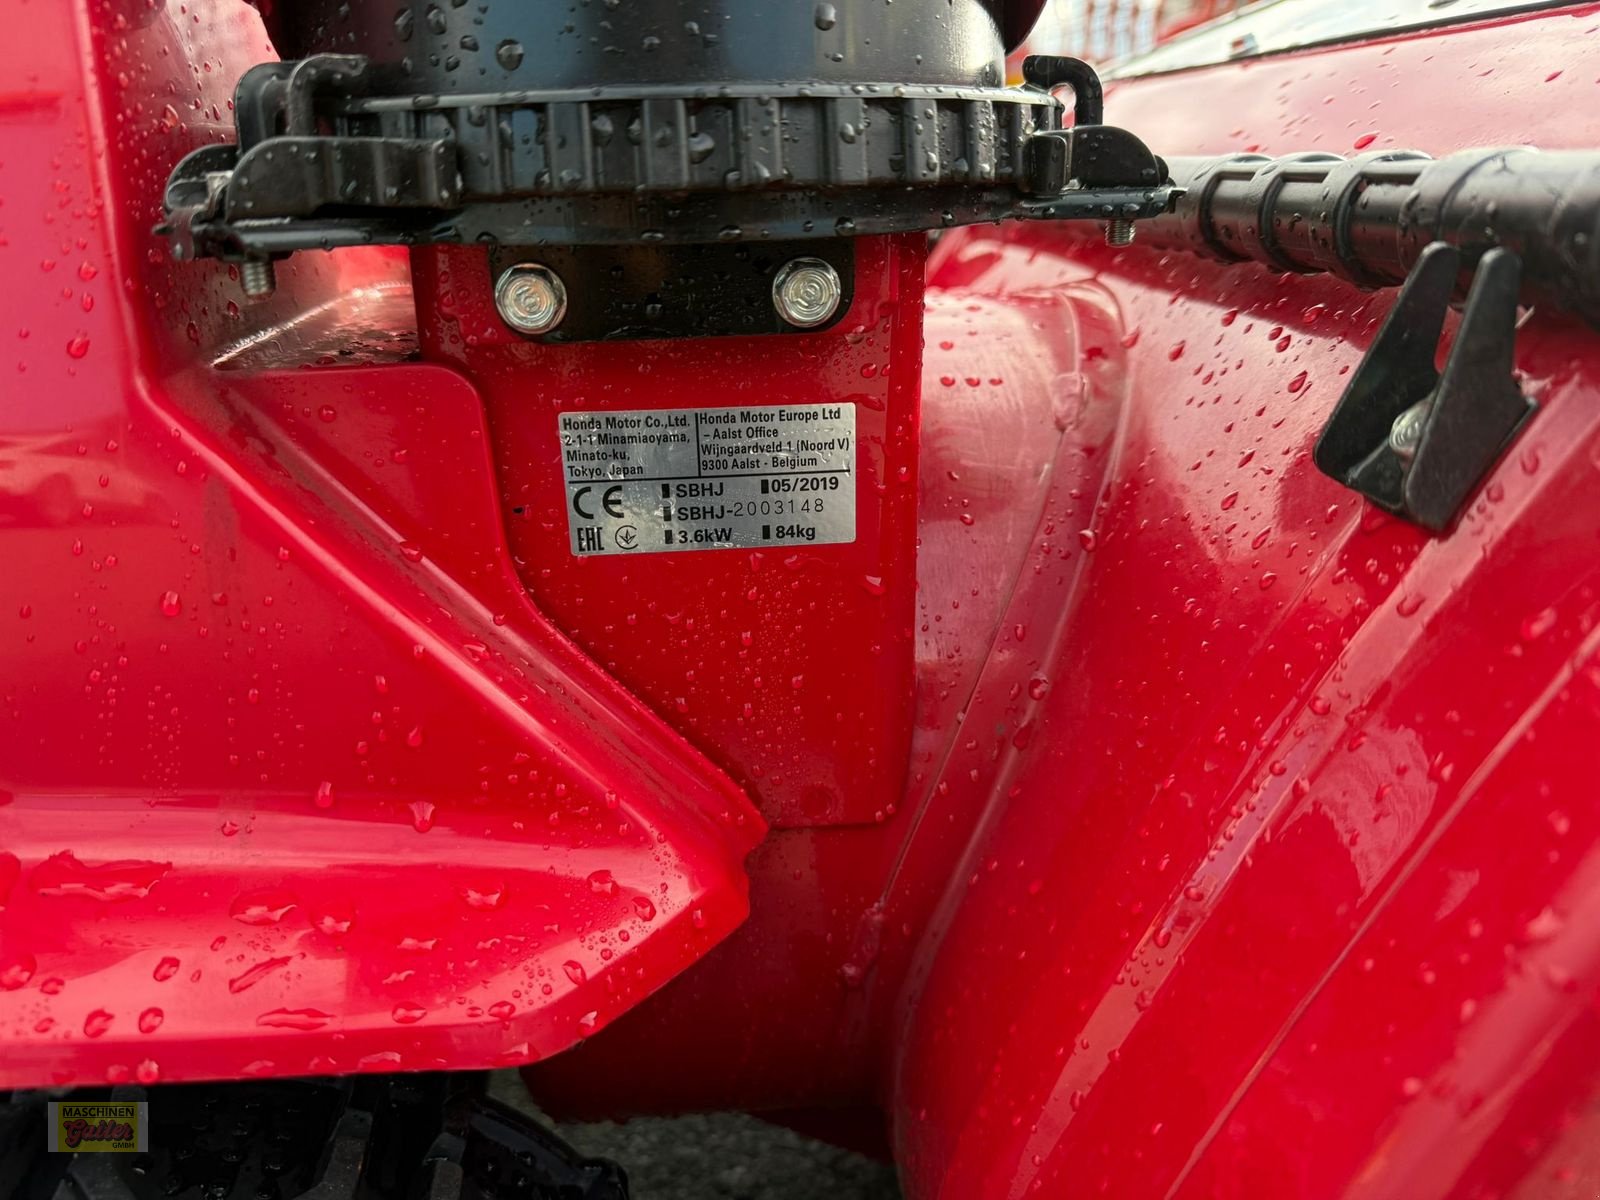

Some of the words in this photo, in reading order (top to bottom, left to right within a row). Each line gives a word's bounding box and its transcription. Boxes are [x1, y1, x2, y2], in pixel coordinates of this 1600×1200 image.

[563, 418, 602, 430] Honda
[605, 416, 641, 429] Motor
[645, 414, 690, 428] Co.,Ltd.
[700, 412, 736, 424] Honda
[740, 411, 775, 423] Motor
[779, 409, 818, 423] Europe
[822, 407, 841, 420] Ltd
[565, 434, 593, 446] 2-1-1
[598, 432, 690, 446] Minamiaoyama,
[713, 428, 742, 439] Aalst
[746, 426, 778, 438] Office
[701, 441, 782, 457] Wijngaardveld
[787, 441, 792, 452] 1
[796, 439, 835, 453] (Noord
[838, 437, 849, 451] V)
[566, 449, 630, 462] Minato-ku,
[702, 459, 728, 470] 9300
[731, 458, 760, 469] Aalst
[772, 456, 817, 470] Belgium
[567, 465, 606, 478] Tokyo,
[609, 464, 643, 477] Japan
[676, 482, 724, 498] SBHJ
[771, 476, 839, 492] 05/2019
[678, 528, 732, 544] 3.6kW
[775, 524, 815, 541] 84kg
